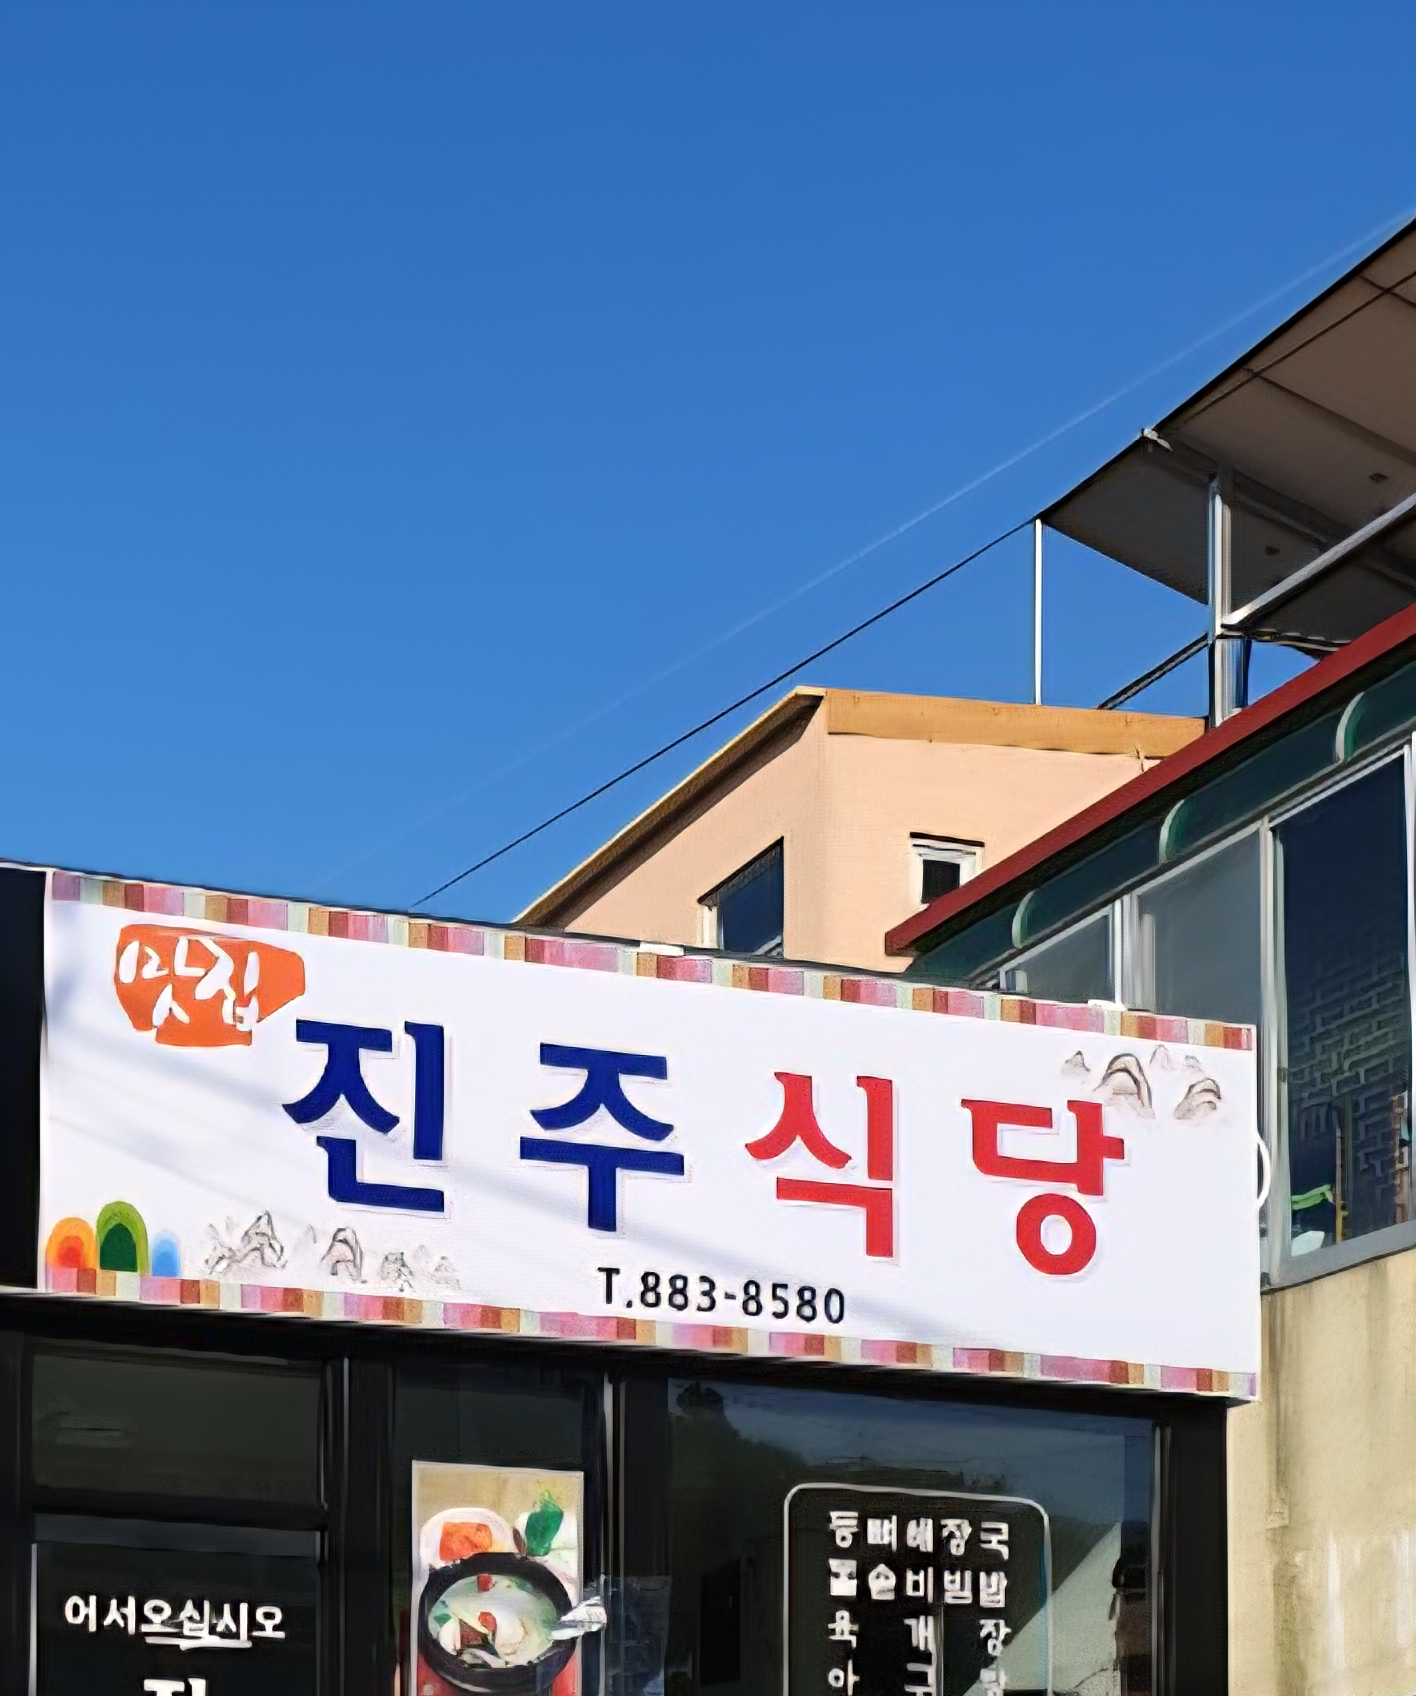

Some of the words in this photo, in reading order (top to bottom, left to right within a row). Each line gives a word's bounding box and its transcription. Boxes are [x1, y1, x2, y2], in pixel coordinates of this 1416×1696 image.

[119, 936, 261, 1032] 맛집
[597, 1266, 847, 1325] T.883-8580
[65, 1594, 286, 1647] 어서오십시오
